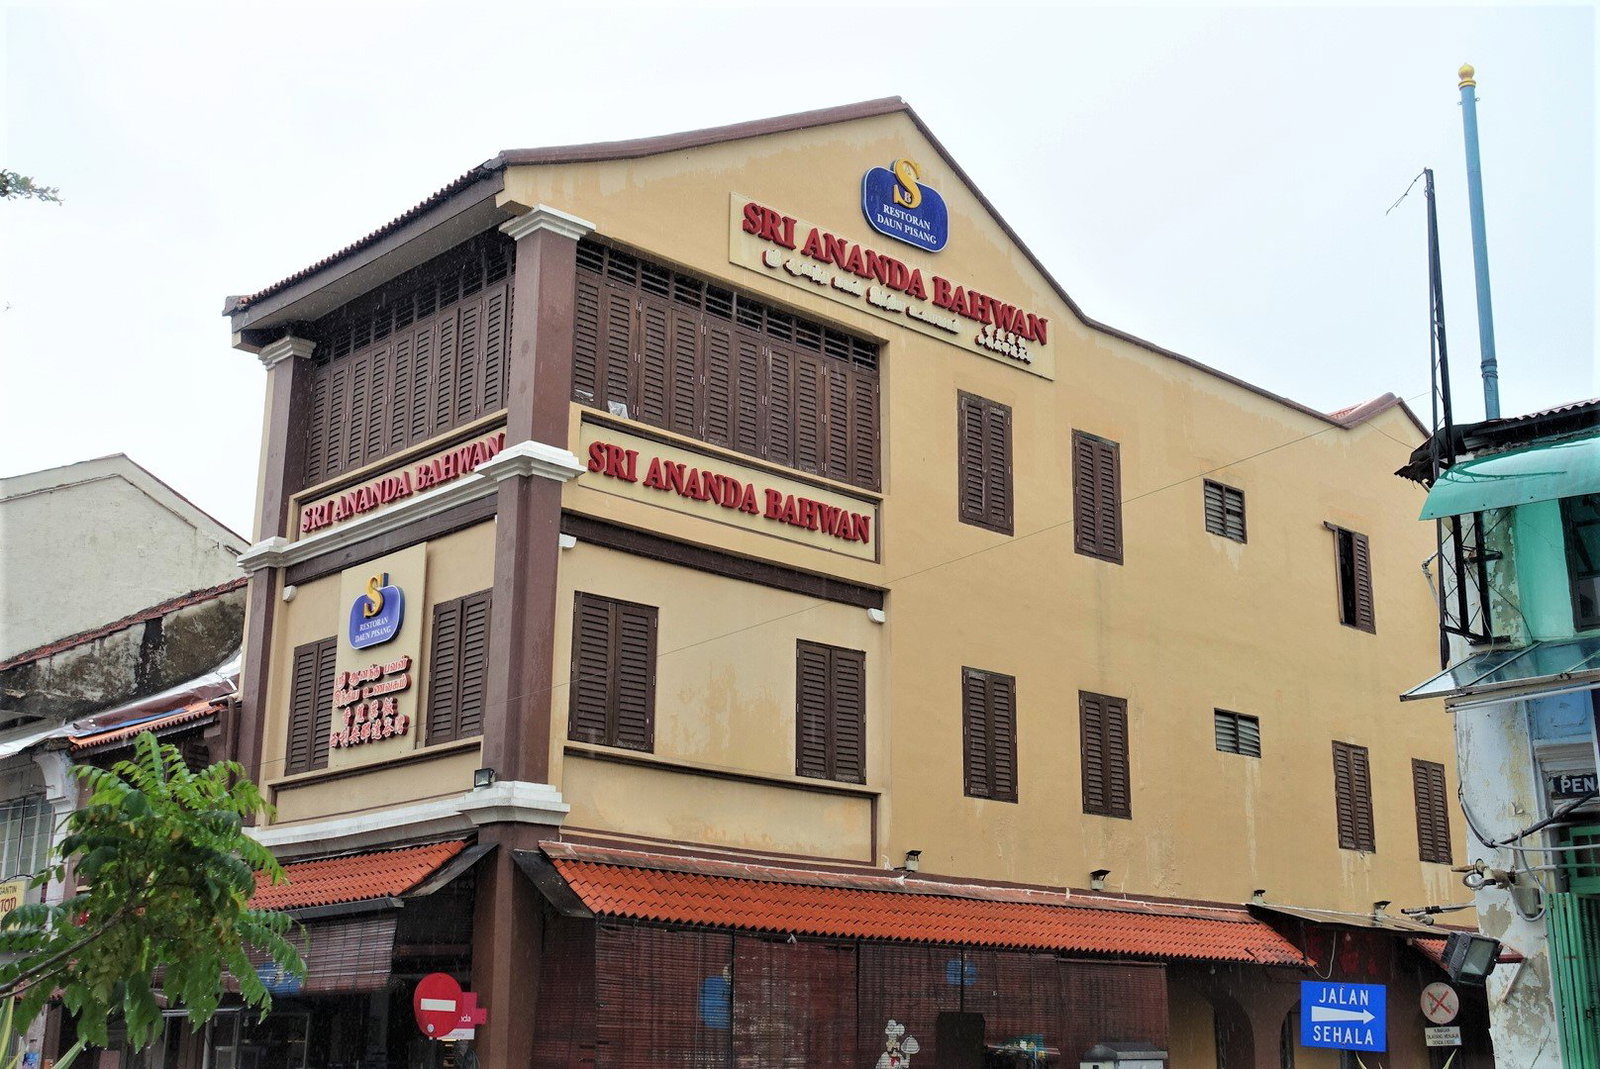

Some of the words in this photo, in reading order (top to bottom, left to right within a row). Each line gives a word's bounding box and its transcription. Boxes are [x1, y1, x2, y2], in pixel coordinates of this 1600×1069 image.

[877, 213, 903, 231] DAUN
[905, 224, 937, 245] PISANG
[883, 203, 931, 231] RESTORAN
[742, 202, 797, 250] SRI
[800, 228, 928, 301] ANANDA
[932, 276, 1048, 345] BAHWAN
[302, 500, 334, 533] SRI
[331, 471, 413, 522] ANANDA
[414, 432, 505, 492] BAHWAN
[588, 441, 639, 483] SRI
[643, 457, 760, 515] ANANDA
[764, 488, 871, 544] BAHWAN
[359, 616, 388, 632] RESTORAN
[370, 625, 392, 639] PISANG
[1319, 987, 1370, 1006] JALAN
[1313, 1025, 1374, 1046] SEHALA
